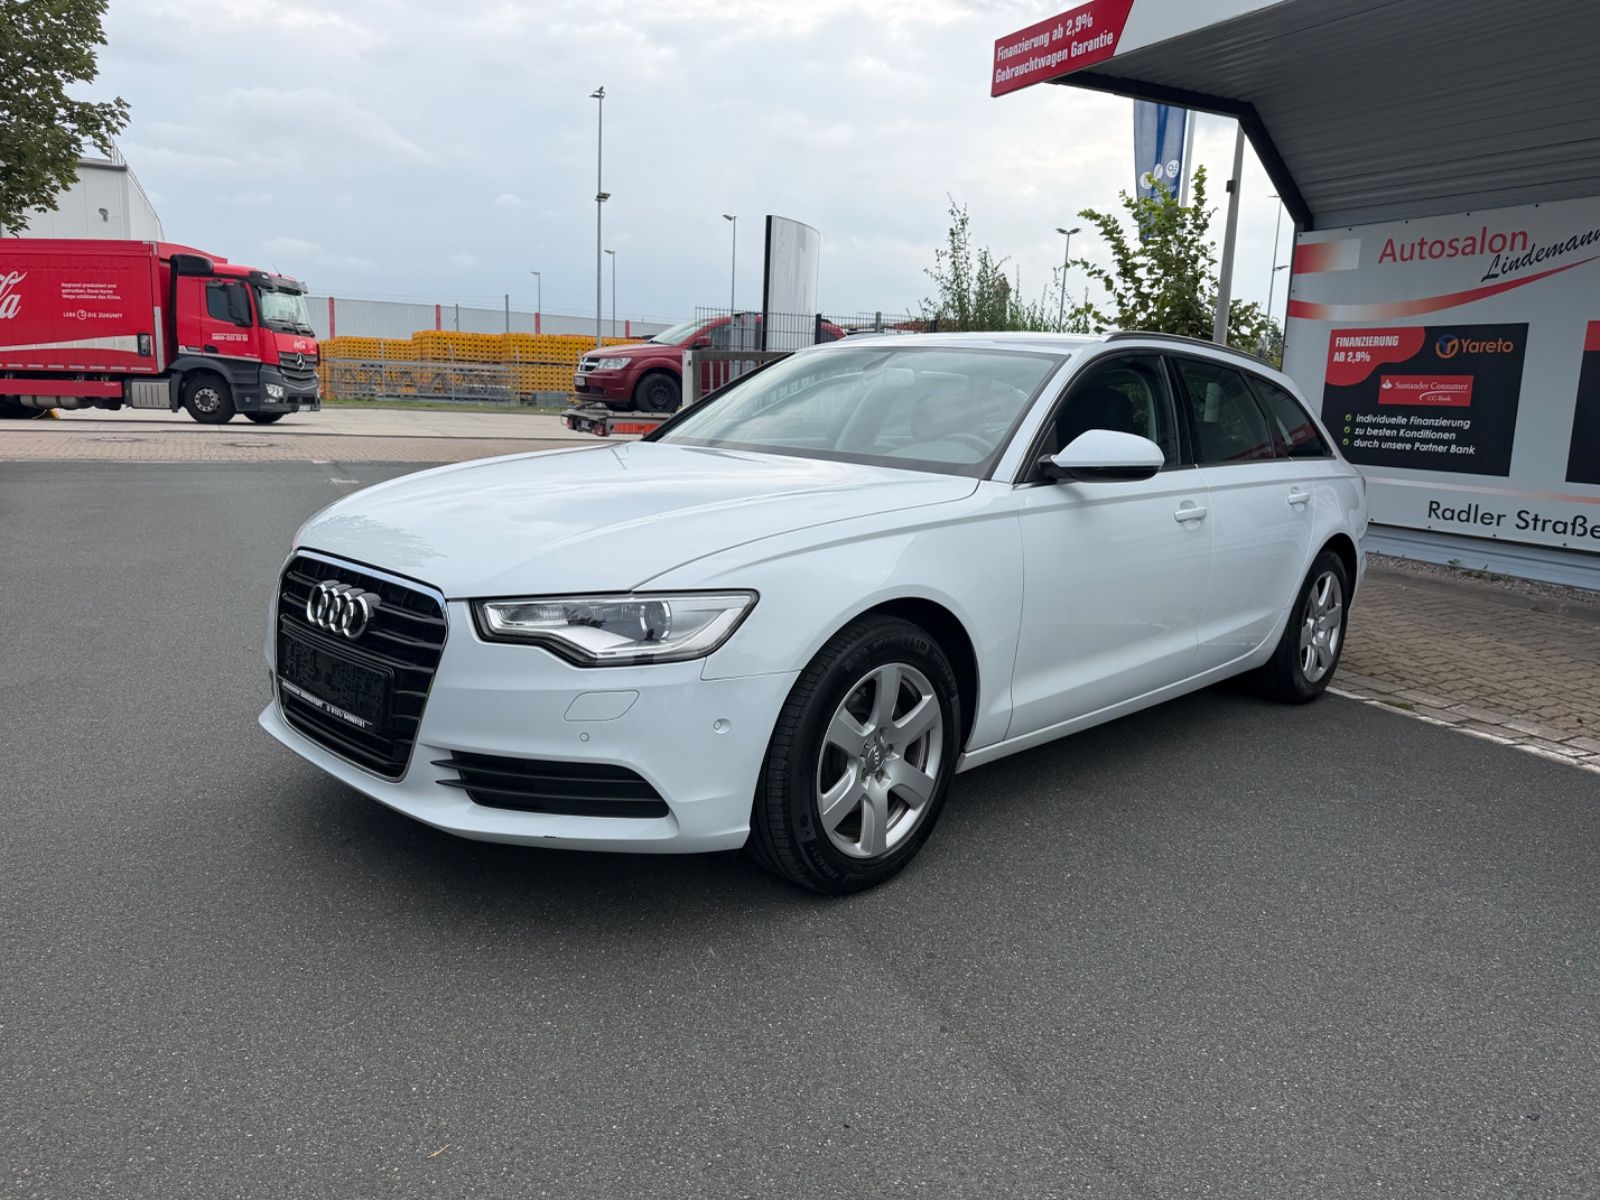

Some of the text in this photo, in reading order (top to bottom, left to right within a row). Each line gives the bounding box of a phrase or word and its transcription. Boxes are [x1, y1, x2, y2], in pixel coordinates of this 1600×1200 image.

[997, 11, 1094, 62] Finanzierung ab 2,9%
[995, 29, 1114, 84] Gebrauchtwagen Garantie
[1378, 226, 1529, 264] Autosalon
[1335, 335, 1399, 348] FINANZIERUNG
[1461, 337, 1514, 354] Yareto
[1333, 351, 1371, 364] AB 2,9%
[1394, 381, 1469, 391] Santander Consumer
[1356, 413, 1472, 430] individuelle Finanzierung
[1354, 426, 1457, 440] zu besten Konditionen
[1353, 438, 1477, 456] durch unsere Partner Bank
[1428, 500, 1600, 540] Radler Straße
